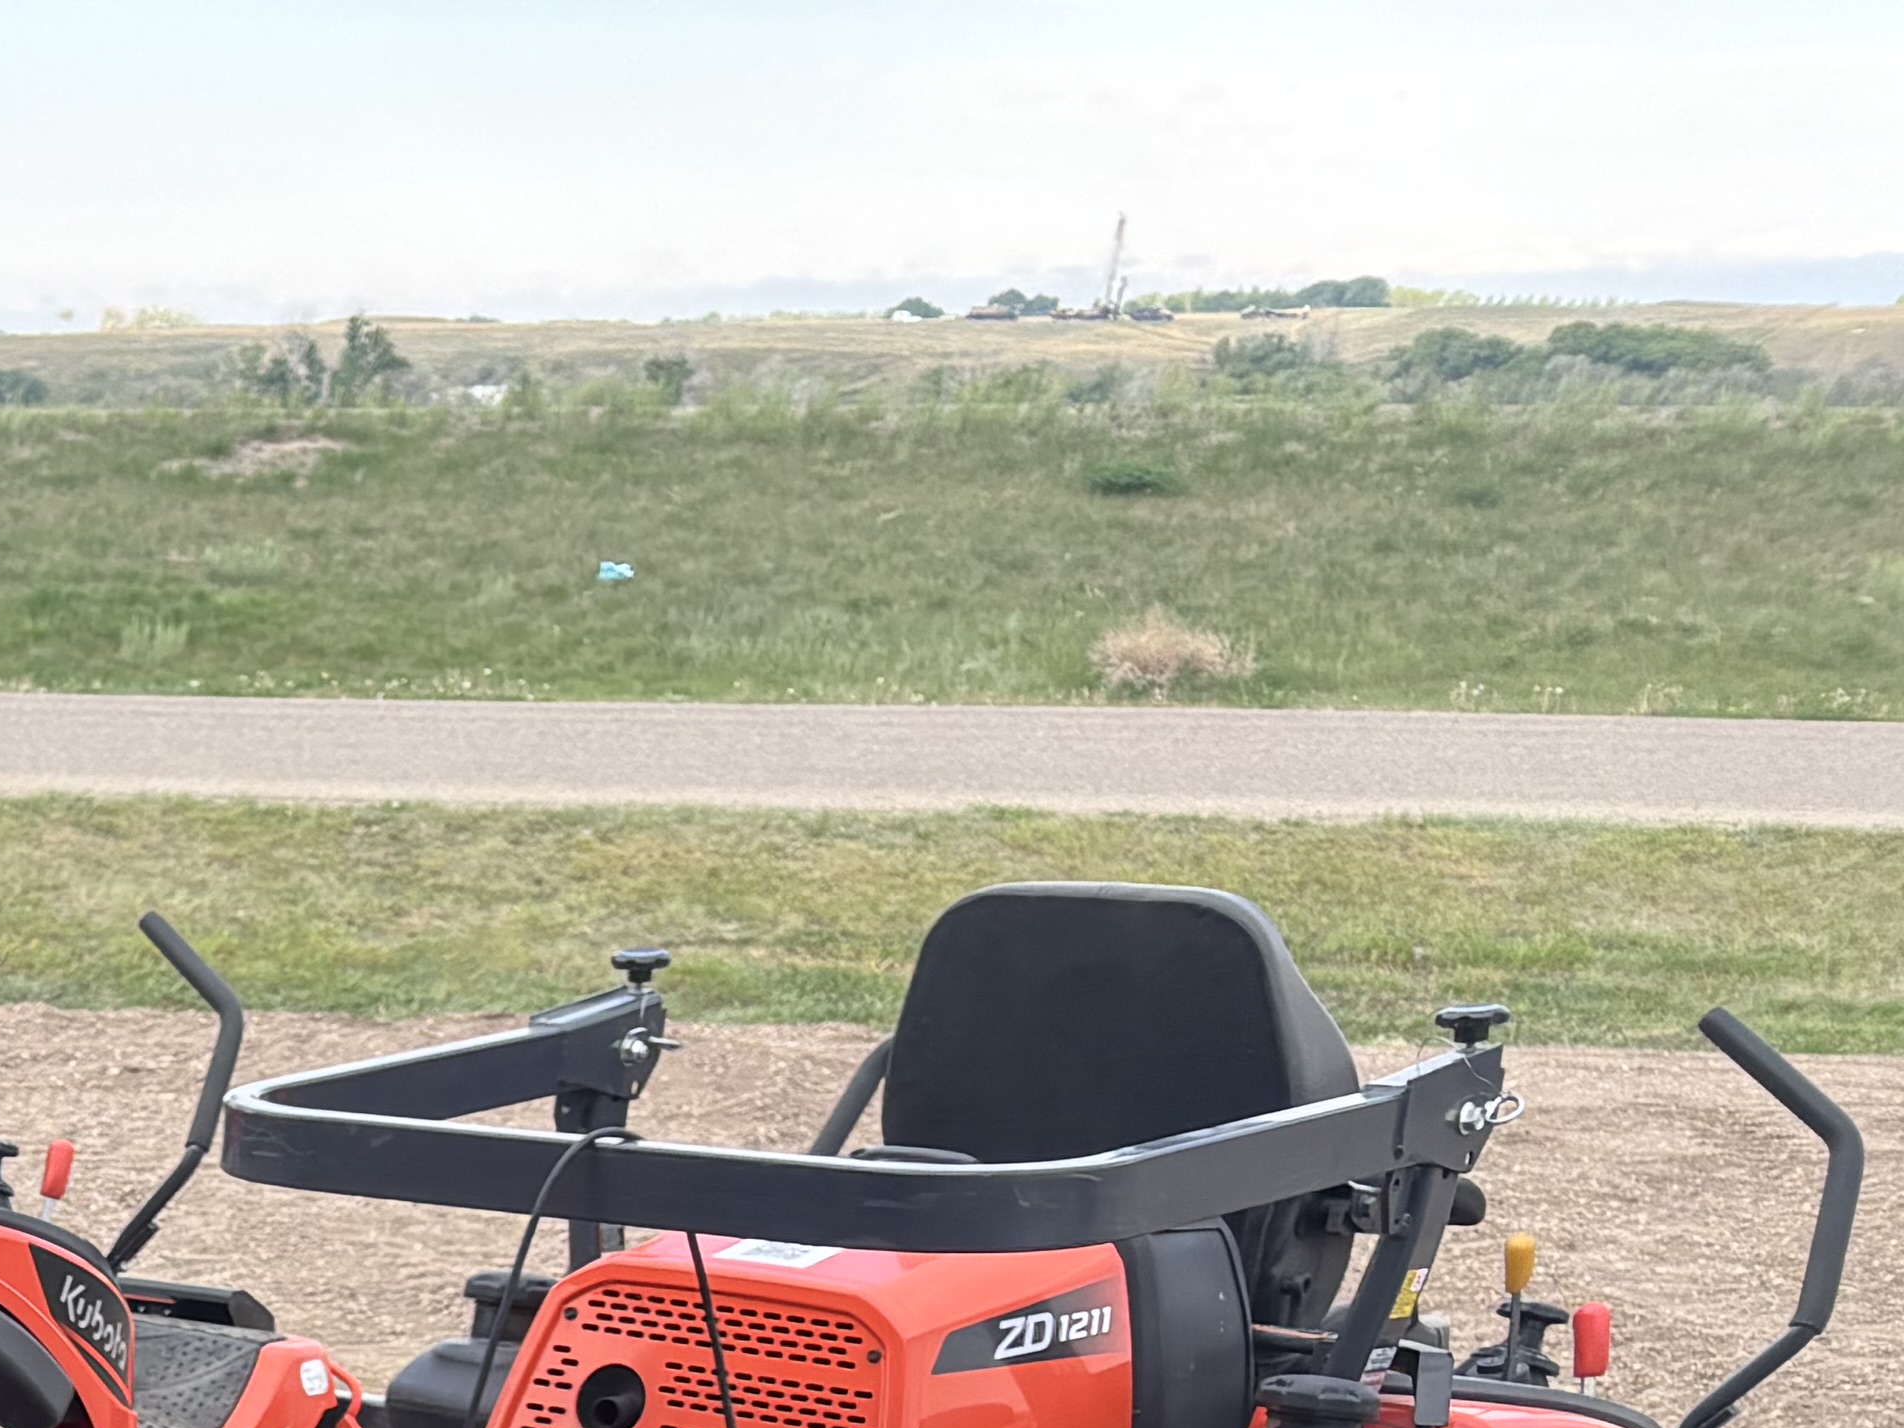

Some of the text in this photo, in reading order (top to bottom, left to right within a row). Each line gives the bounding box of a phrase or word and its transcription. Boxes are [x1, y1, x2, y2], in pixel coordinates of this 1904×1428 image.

[60, 1275, 127, 1371] Kubota
[994, 1306, 1112, 1360] ZD 1211
